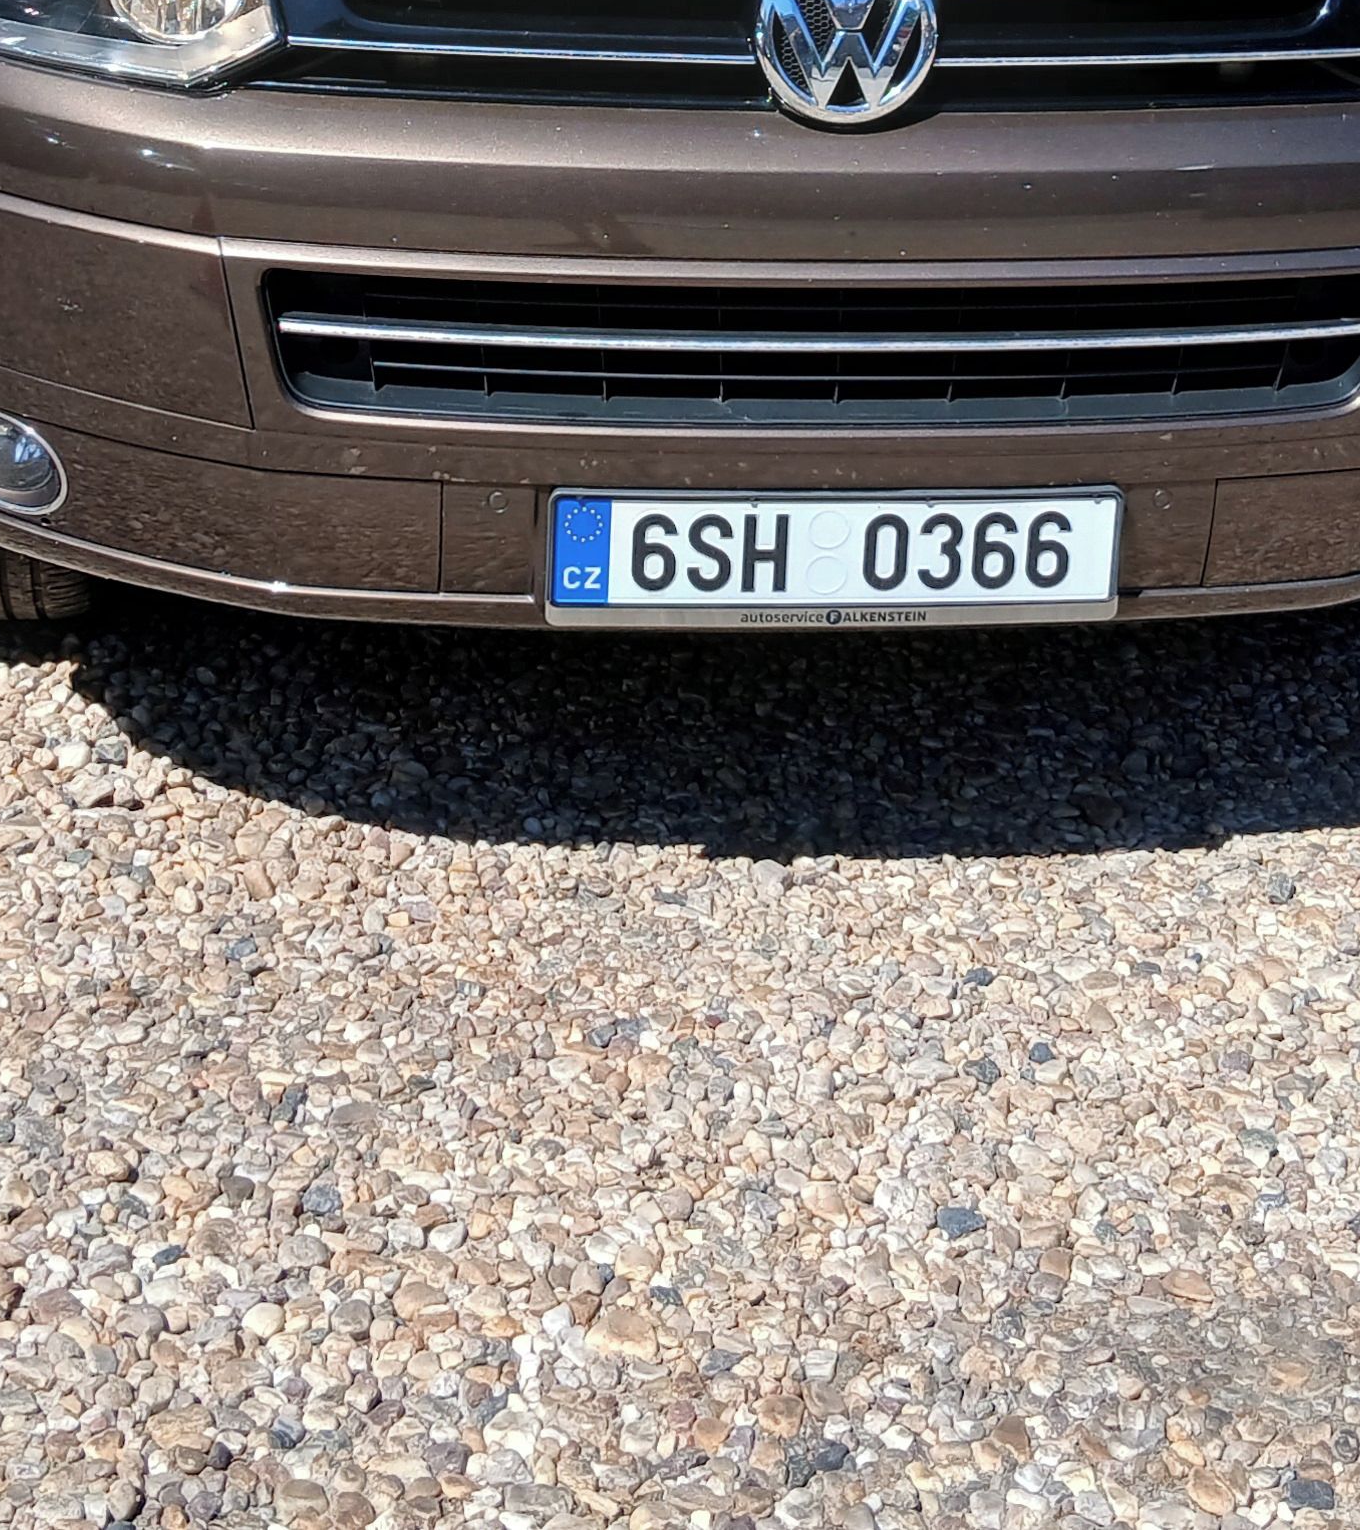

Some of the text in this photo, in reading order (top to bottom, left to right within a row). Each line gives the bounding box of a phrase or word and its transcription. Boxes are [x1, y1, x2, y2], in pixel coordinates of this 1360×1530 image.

[562, 510, 1073, 592] CZ 6SH 0366
[740, 610, 824, 623] autoservice
